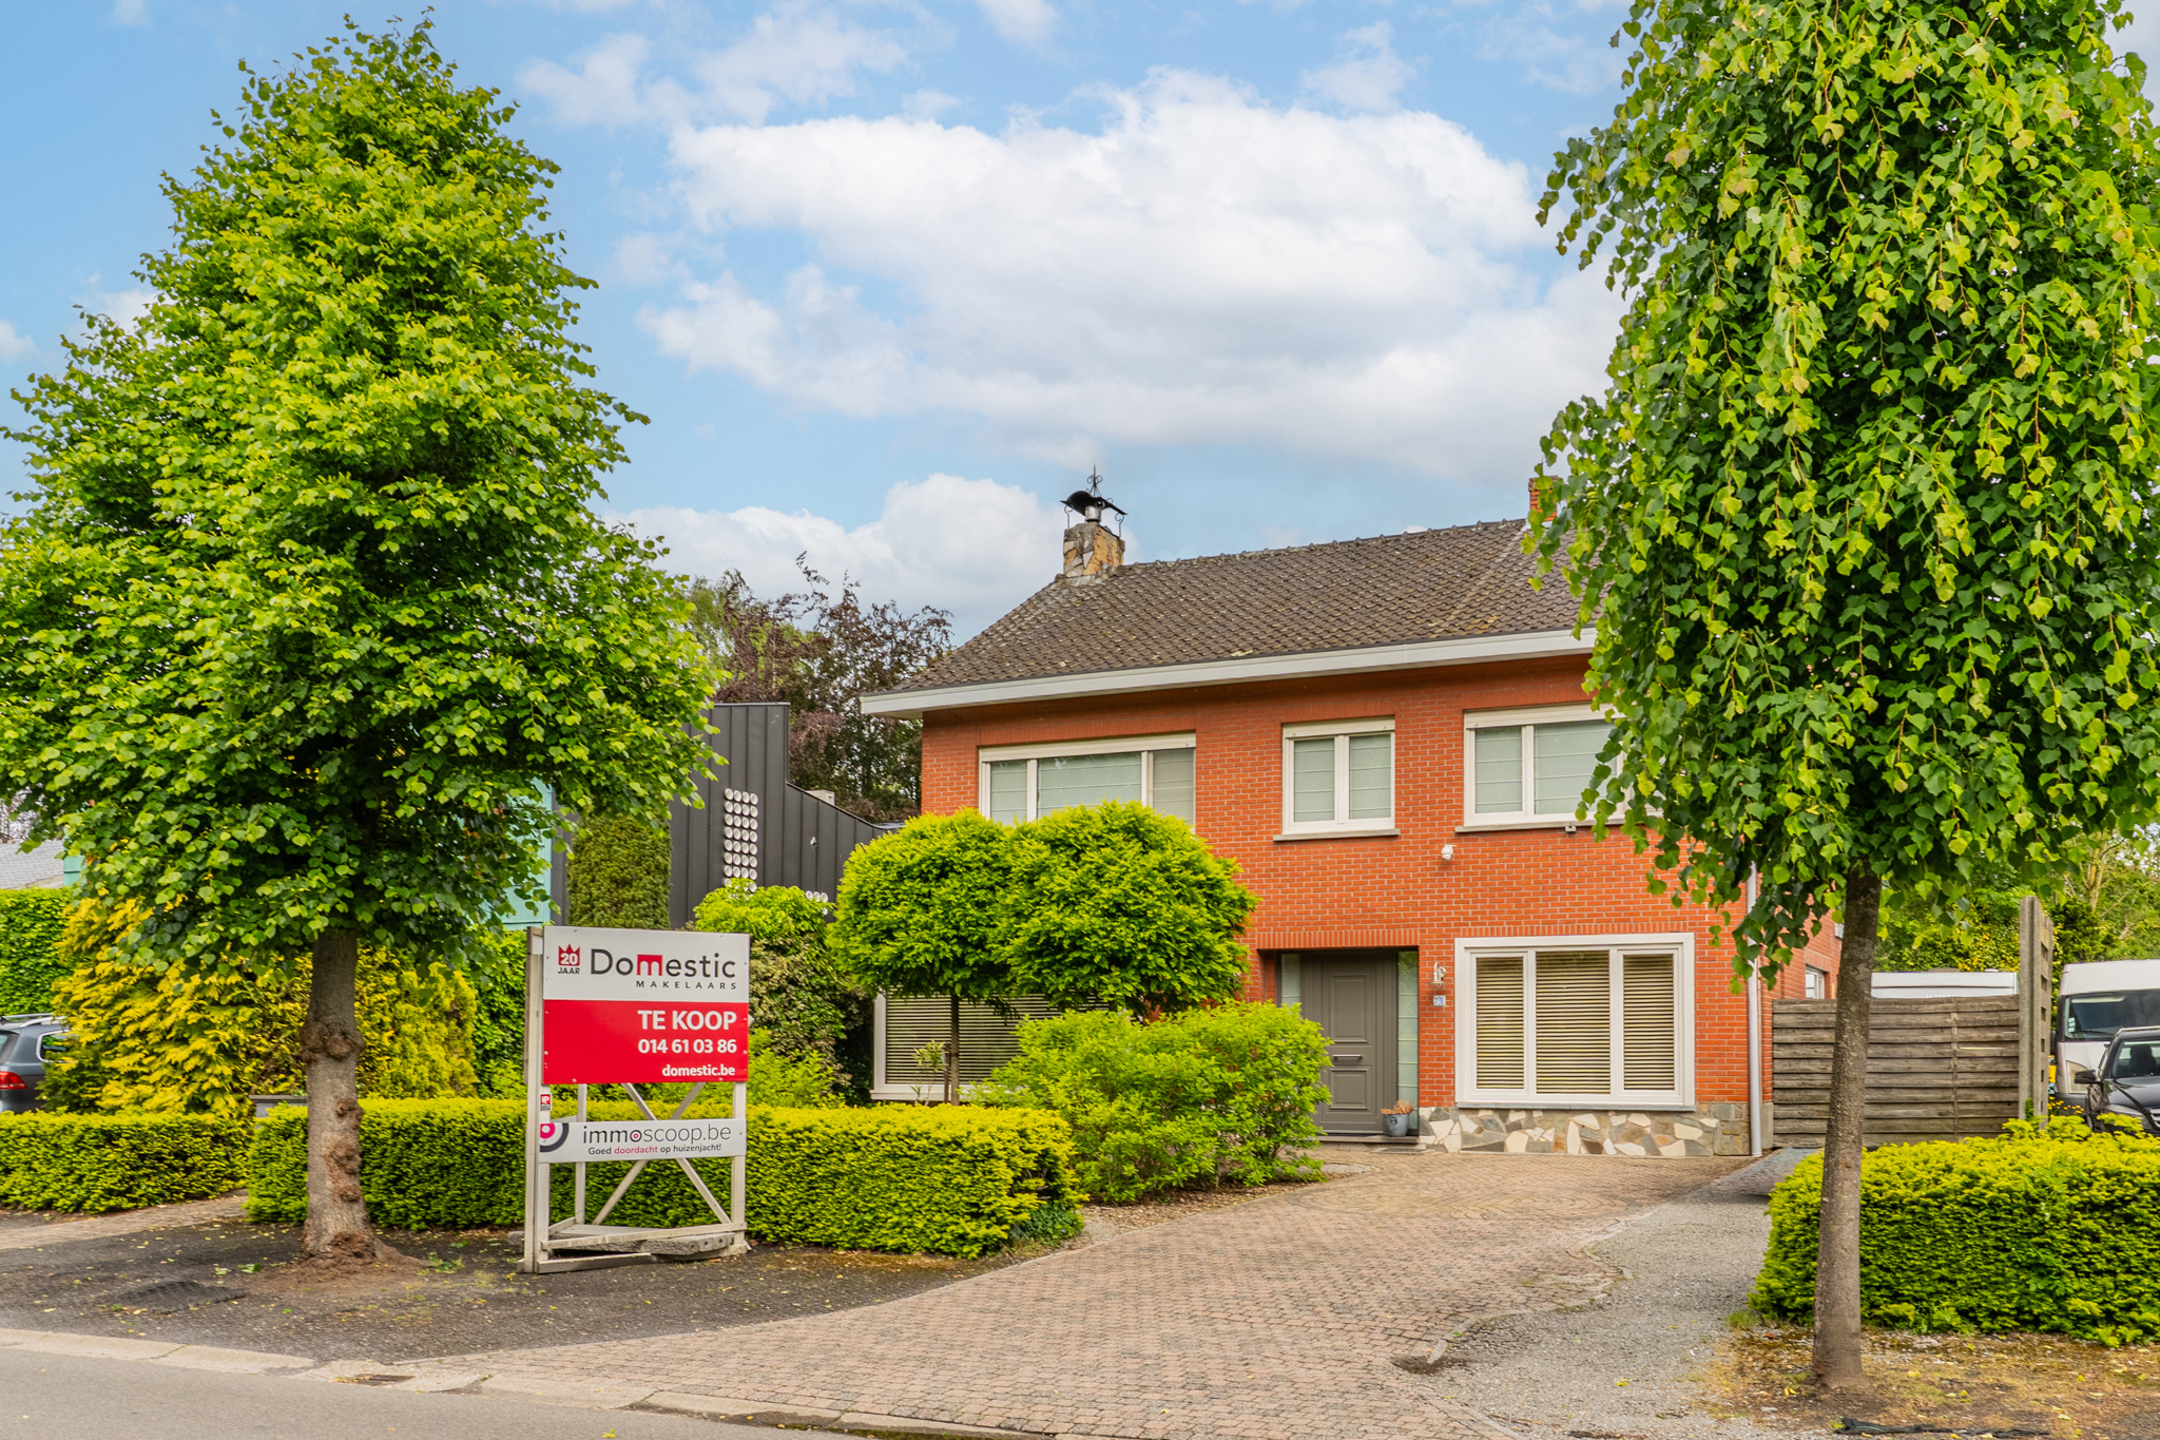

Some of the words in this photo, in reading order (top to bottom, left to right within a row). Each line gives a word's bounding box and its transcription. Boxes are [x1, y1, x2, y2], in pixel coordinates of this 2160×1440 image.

[560, 953, 578, 965] 20
[590, 948, 736, 978] Domestic
[558, 967, 580, 975] JAAR
[636, 980, 736, 990] MAKELAARS
[637, 1010, 666, 1030] TE
[672, 1010, 737, 1031] KOOP
[638, 1038, 668, 1054] 014
[671, 1039, 690, 1054] 61
[693, 1039, 714, 1054] 03
[717, 1039, 737, 1054] 86
[662, 1064, 735, 1077] domestic.be
[583, 1123, 731, 1145] immoscoop.be
[588, 1146, 612, 1155] Goed
[614, 1145, 658, 1155] doordacht
[660, 1146, 671, 1154] op
[673, 1143, 721, 1153] huizenjacht!
